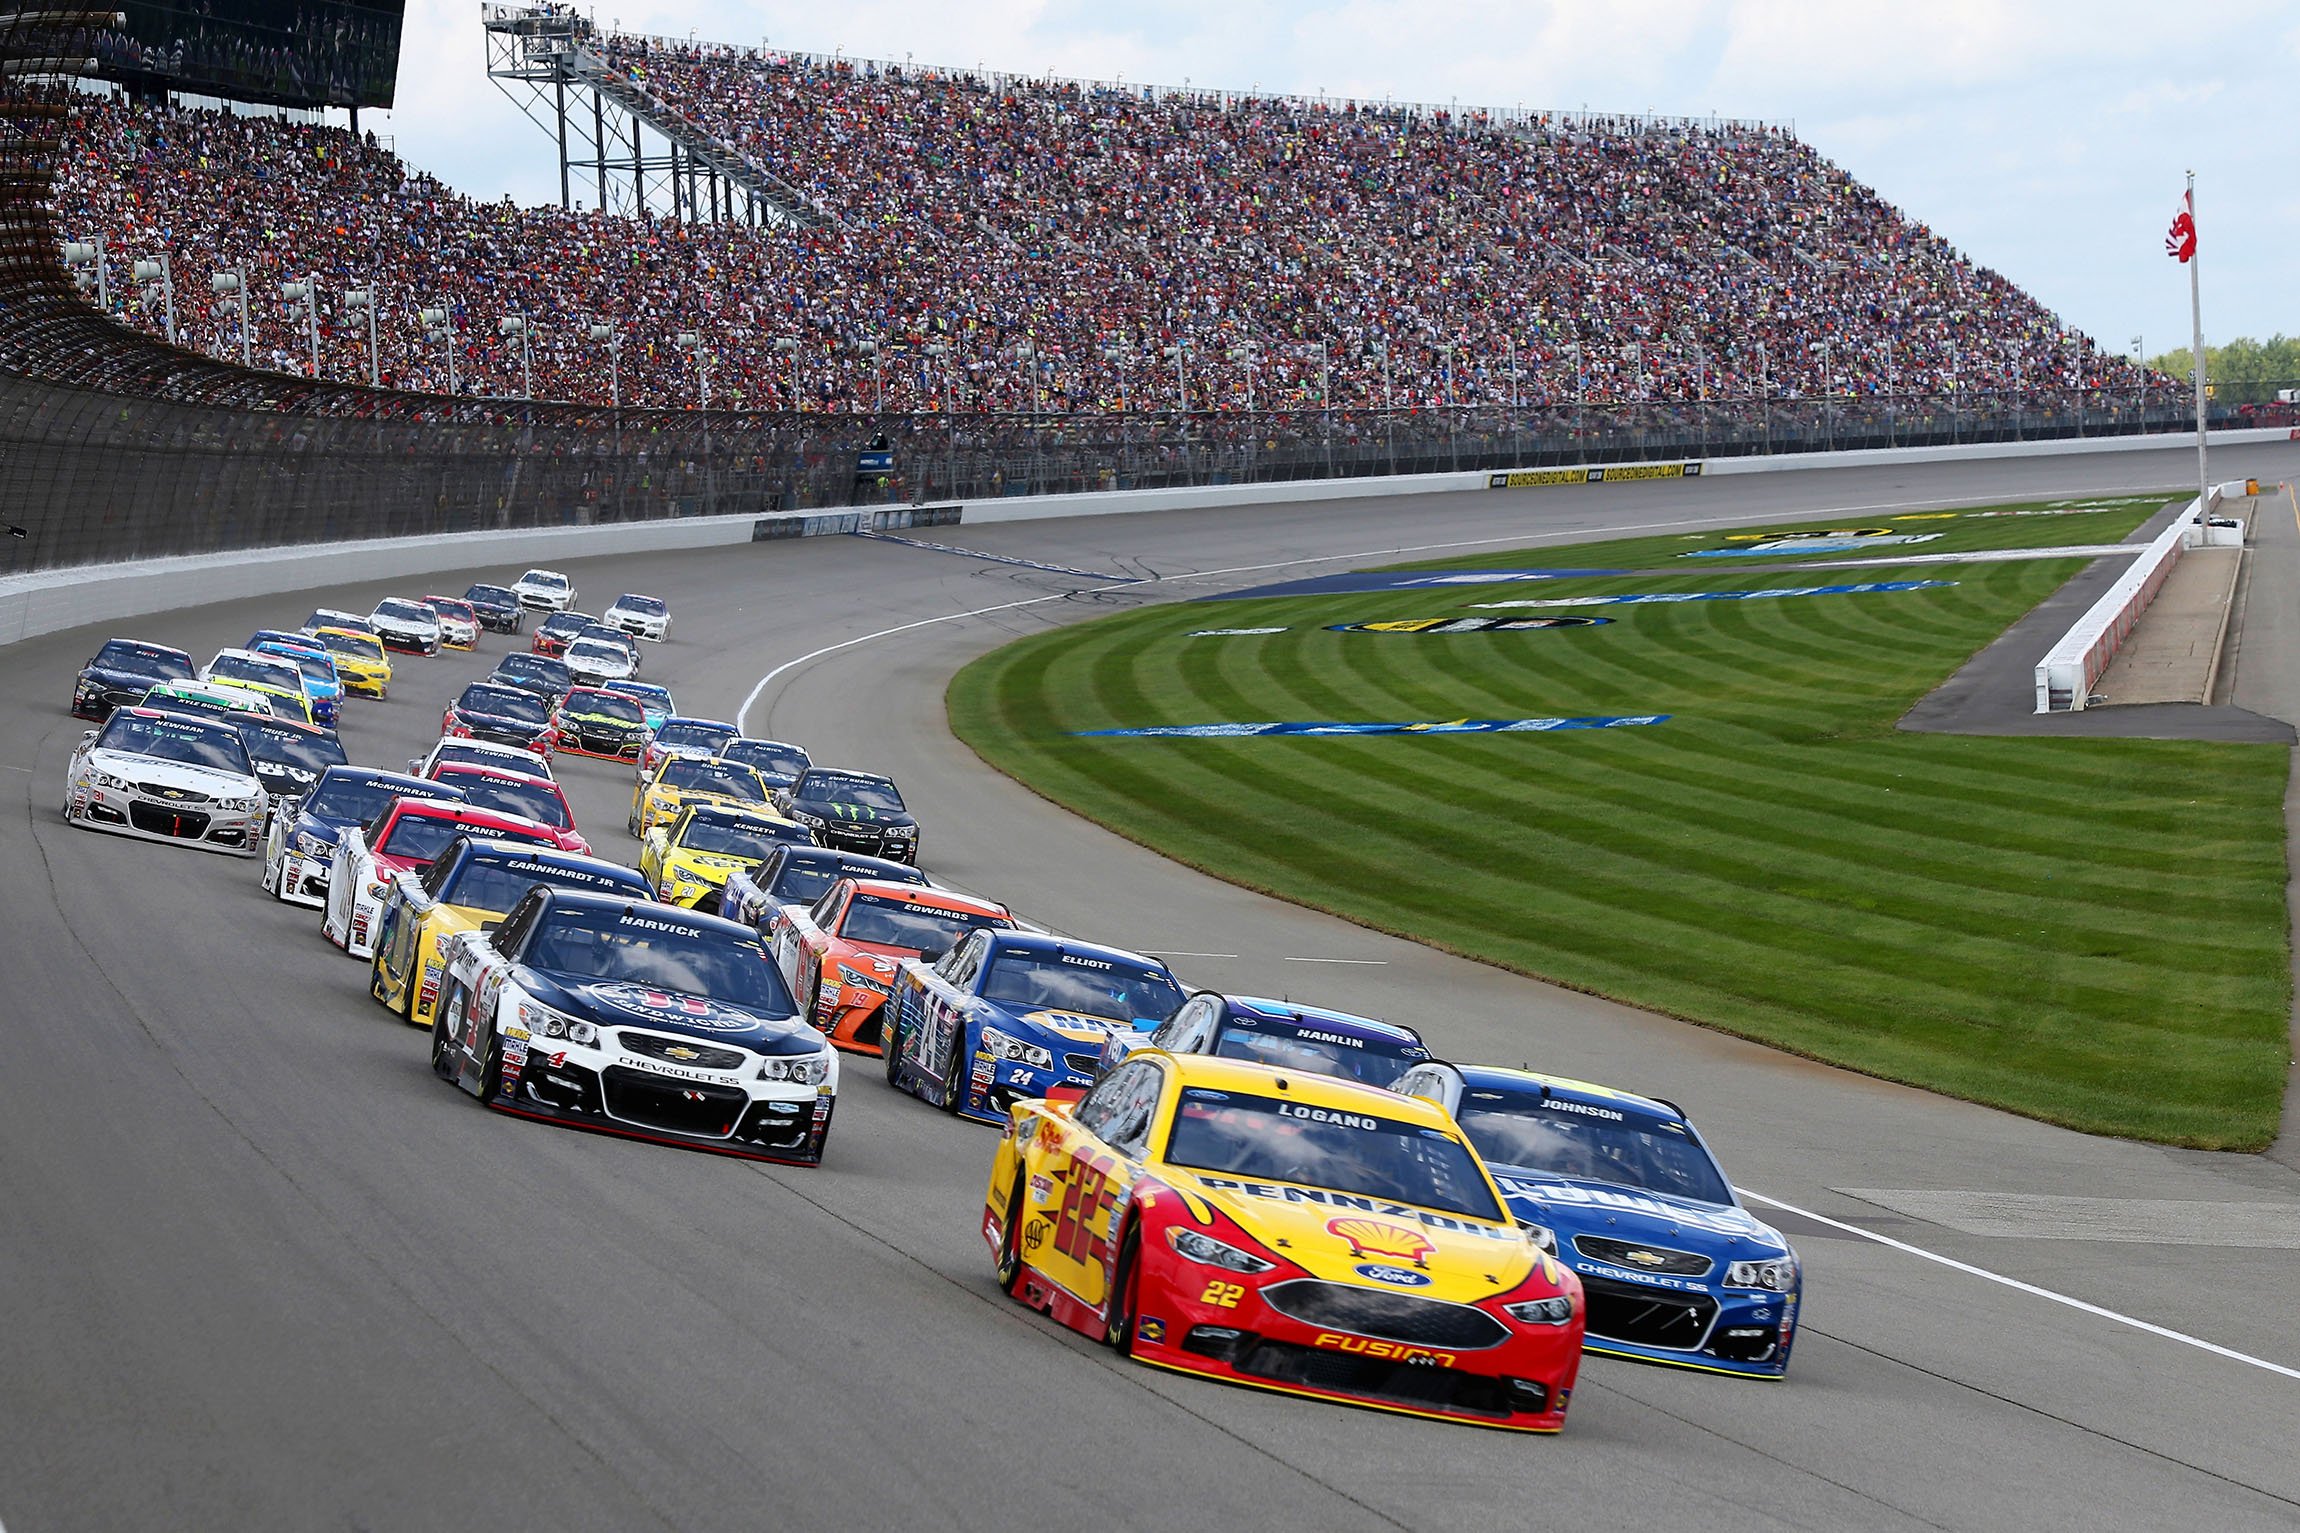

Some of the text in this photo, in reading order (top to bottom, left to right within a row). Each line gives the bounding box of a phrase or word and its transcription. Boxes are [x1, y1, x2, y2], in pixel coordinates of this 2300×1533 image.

[1510, 470, 1587, 486] SOURCEONEDIGITAL.COM
[1606, 465, 1683, 481] SOURCEONEDIGITAL.COM
[178, 699, 200, 707] KYLE
[155, 720, 204, 733] NEWMAN
[260, 727, 289, 737] TRUEX
[474, 748, 514, 760] STEWART
[366, 780, 434, 798] McMURRAY
[481, 776, 522, 788] LARSON
[93, 790, 104, 801] 31
[455, 823, 505, 838] BLANEY
[734, 823, 776, 835] KENSETH
[320, 867, 327, 877] 1
[507, 860, 615, 888] EARNHARDT JR
[841, 865, 878, 877] KAHNE
[681, 886, 695, 897] 20
[904, 903, 969, 921] EDWARDS
[619, 916, 700, 938] HARVICK
[1062, 956, 1113, 970] ELLIOTT
[850, 991, 868, 1006] 19
[506, 1027, 530, 1041] MOOG
[1297, 1029, 1363, 1048] HAMLIN
[503, 1038, 529, 1052] MAHLE
[547, 1051, 567, 1069] 4
[975, 1051, 996, 1063] MOOG
[619, 1057, 739, 1085] CHEVROLET SS
[1009, 1068, 1034, 1085] 24
[1278, 1104, 1377, 1131] LOGANO
[1540, 1099, 1623, 1122] JOHNSON
[1054, 1145, 1115, 1266] 22
[1195, 1174, 1524, 1241] PENNZOIL
[1367, 1265, 1421, 1286] Ford
[1577, 1262, 1709, 1292] CHEVROLET SS
[1201, 1281, 1245, 1309] 22
